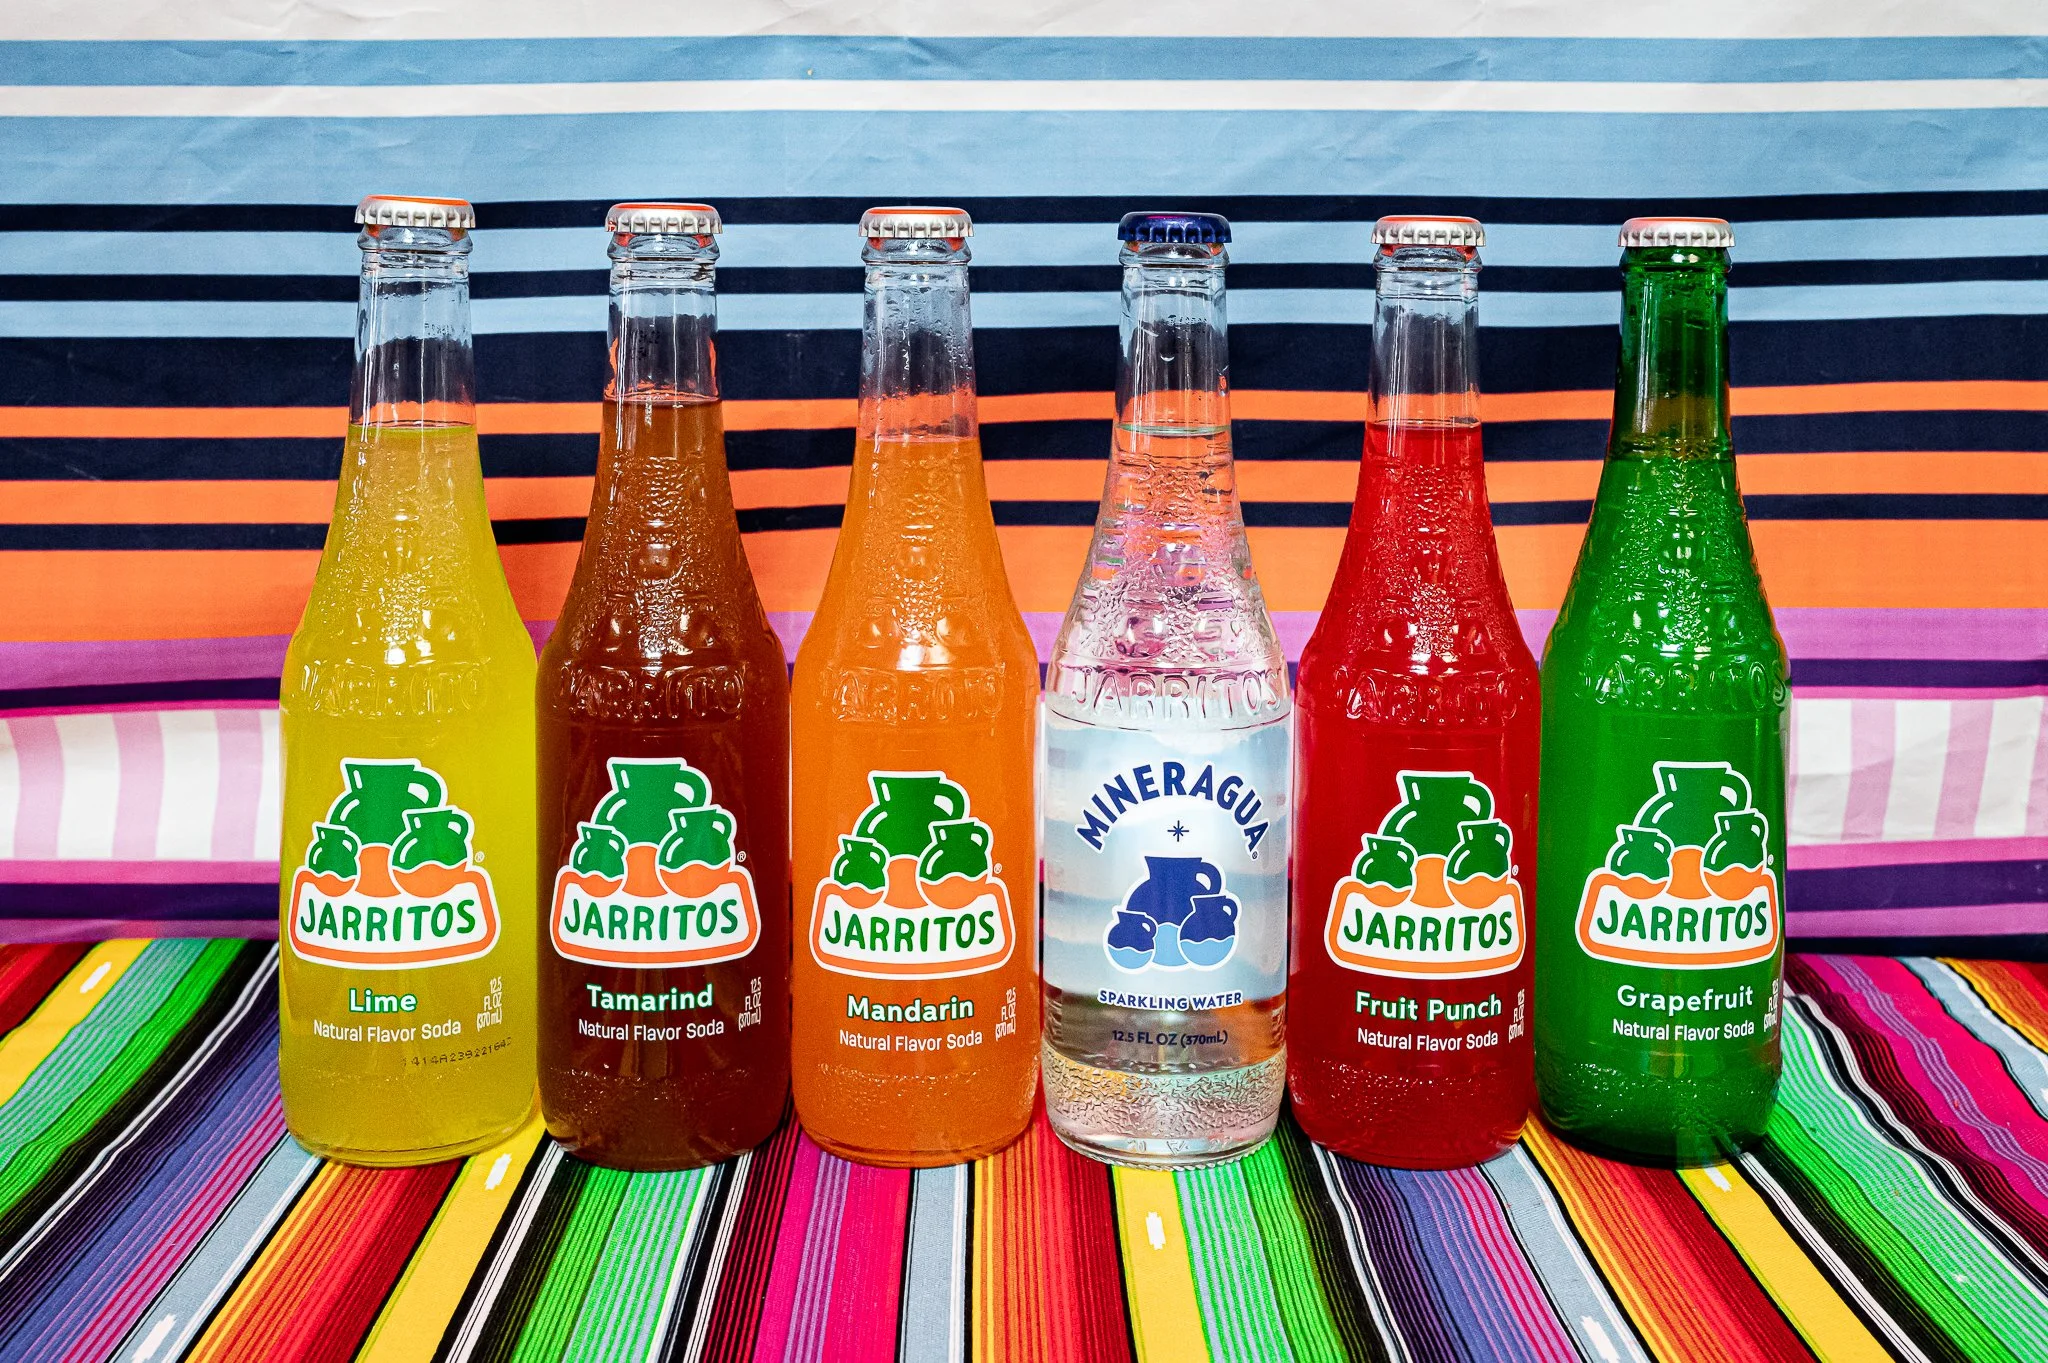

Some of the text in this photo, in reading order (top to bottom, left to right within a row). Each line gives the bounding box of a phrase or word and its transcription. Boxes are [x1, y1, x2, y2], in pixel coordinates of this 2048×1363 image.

[1071, 666, 1282, 720] JARRITOS
[1076, 761, 1269, 852] MINERAGUA
[300, 898, 476, 942] JARRITOS
[563, 898, 739, 941] JARRITOS
[824, 909, 995, 953] JARRITOS
[1343, 908, 1513, 952] JARRITOS
[1596, 899, 1767, 943] JARRITOS
[350, 989, 417, 1012] Lime
[586, 983, 713, 1012] Tamarind
[847, 995, 973, 1023] Mandarin
[1099, 990, 1242, 1010] SPARKLING WATER
[1356, 990, 1502, 1021] Fruit Punch
[1617, 984, 1754, 1017] Grapefruit
[313, 1019, 462, 1043] Natural Flavor Soda
[578, 1018, 725, 1042] Natural Flavor Soda
[839, 1029, 983, 1052] Natural Flavor Soda
[1112, 1029, 1135, 1043] 12.5
[1137, 1031, 1153, 1045] FL
[1156, 1032, 1178, 1046] OZ
[1357, 1027, 1499, 1052] Natural Flavor Soda
[1612, 1018, 1670, 1041] Natural
[1674, 1024, 1721, 1042] Flavor
[1723, 1019, 1755, 1040] Soda
